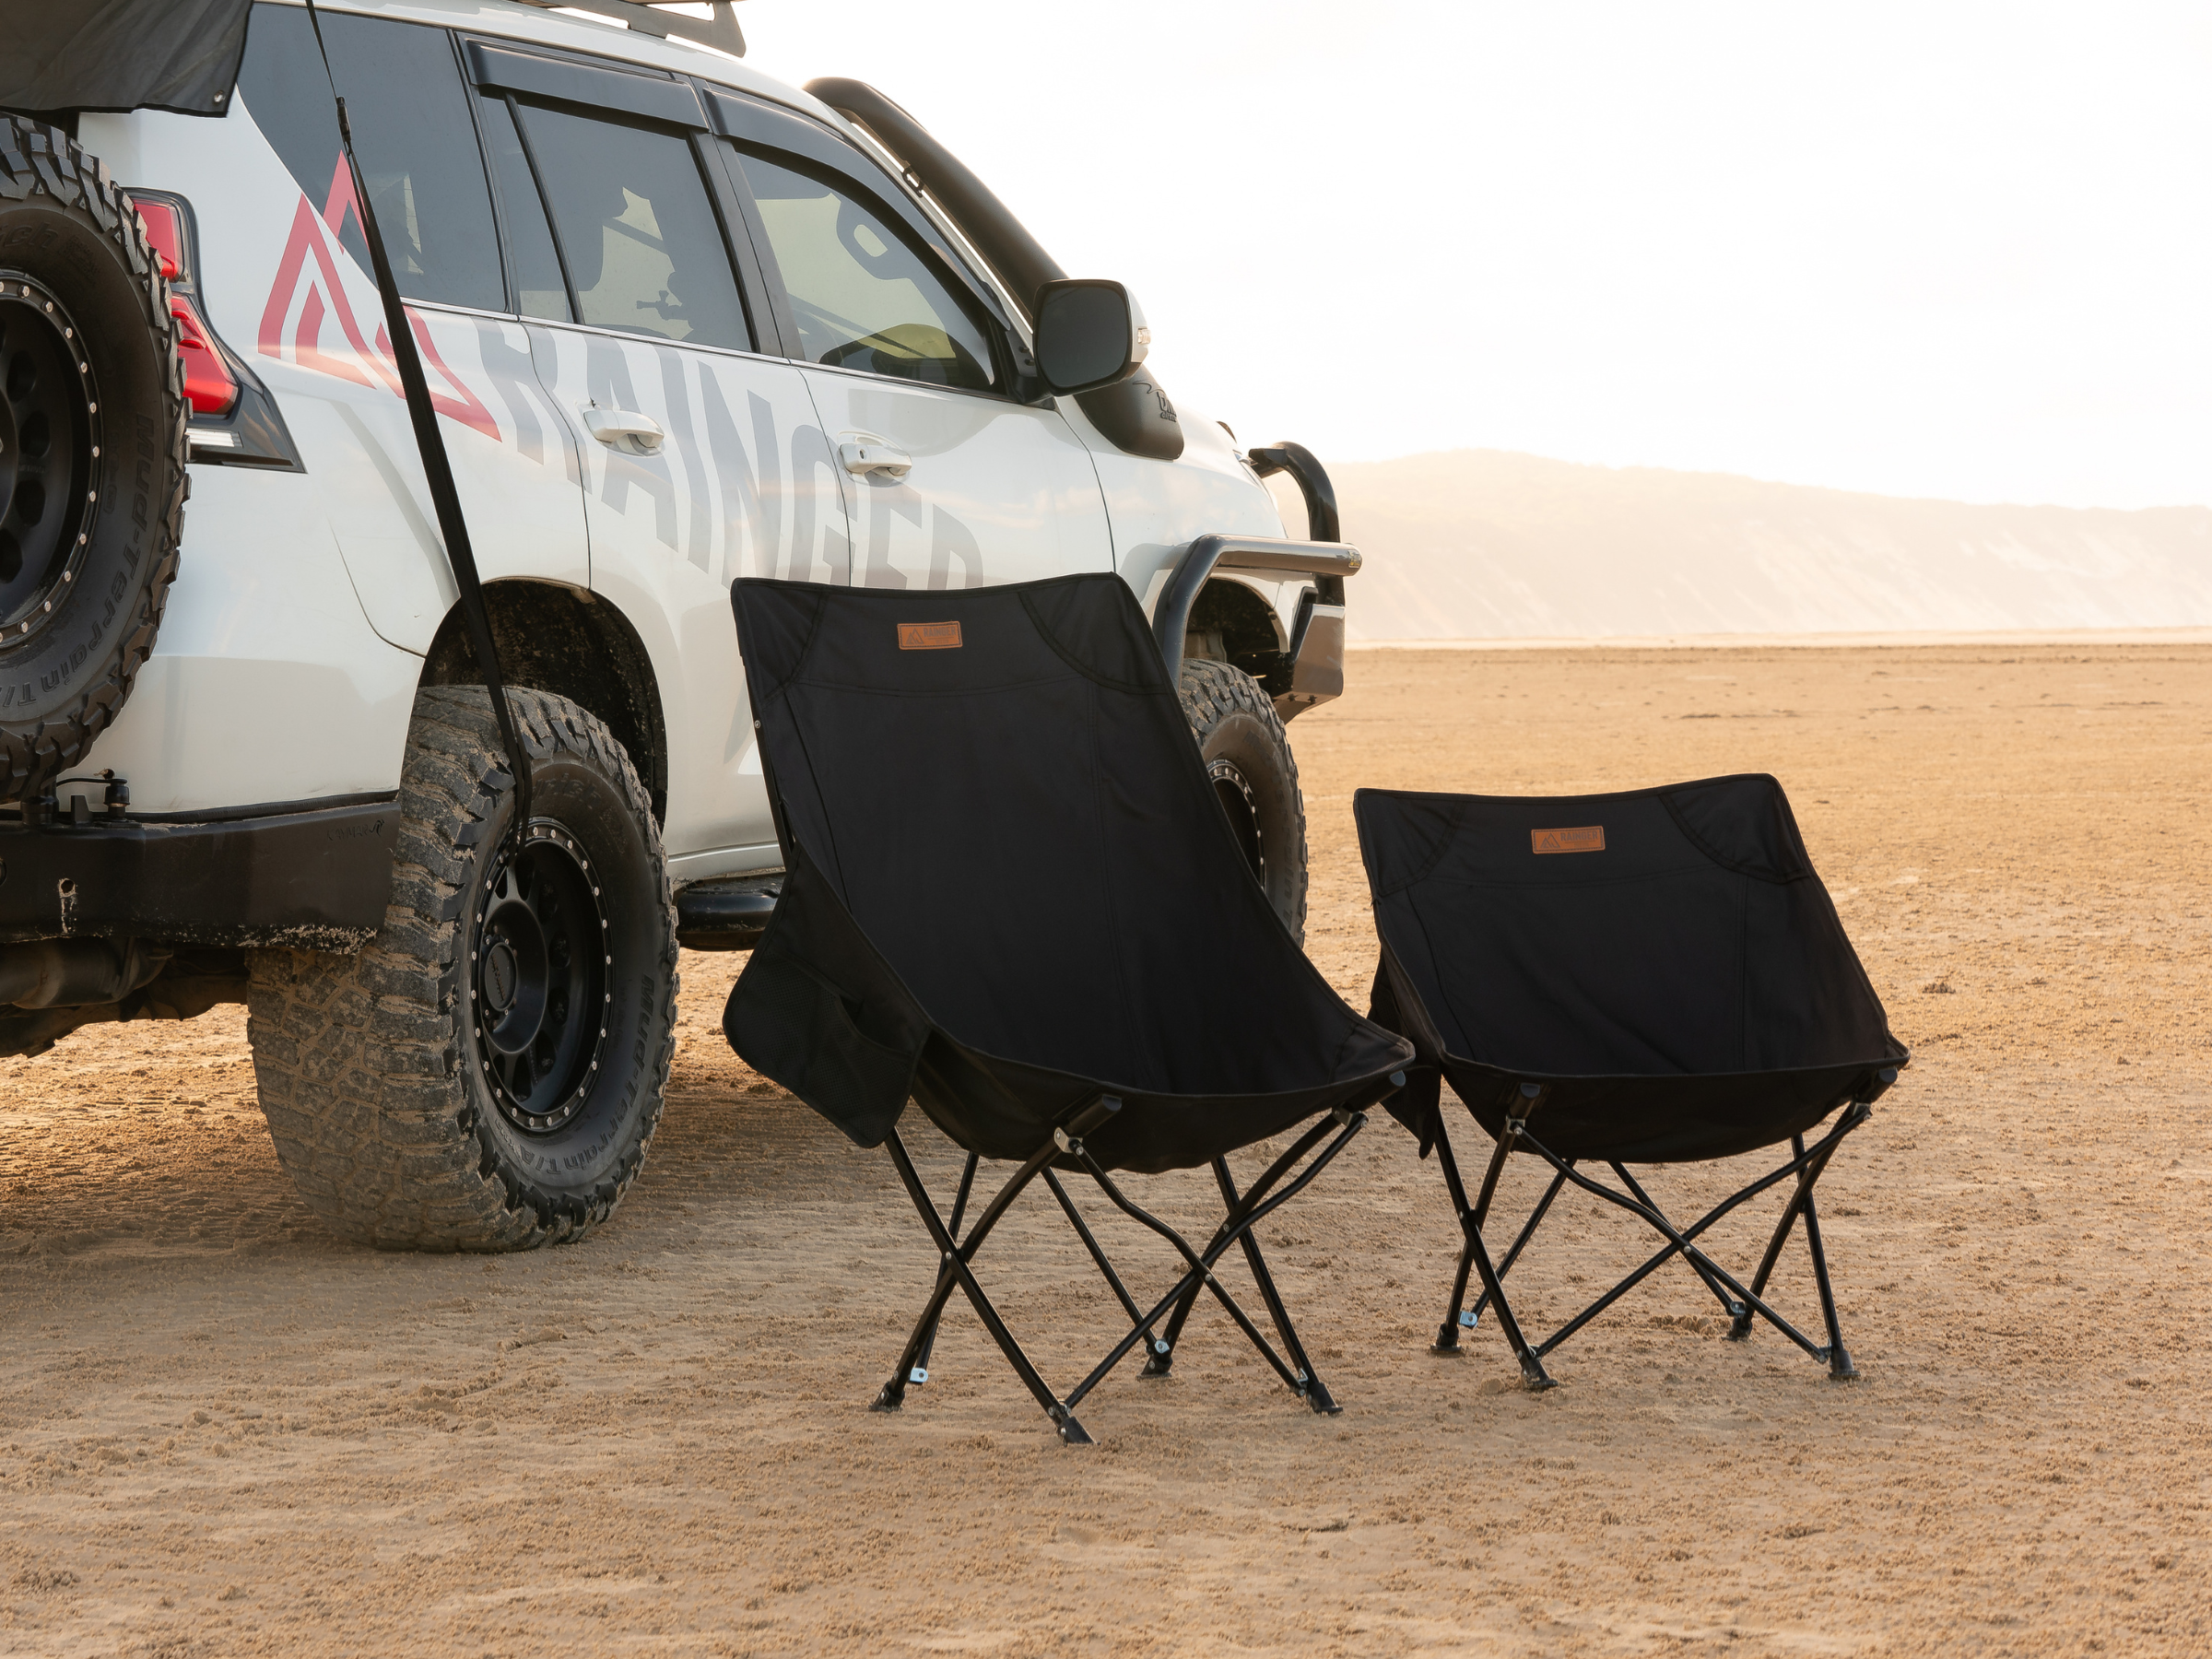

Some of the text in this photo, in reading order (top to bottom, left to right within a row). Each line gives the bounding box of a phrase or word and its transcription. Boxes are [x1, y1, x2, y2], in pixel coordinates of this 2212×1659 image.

[0, 412, 155, 707] Mud-Terrain T/
[923, 626, 957, 638] RAINGER
[1559, 830, 1599, 841] RAINGER
[563, 972, 655, 1170] Mud-Terrain
